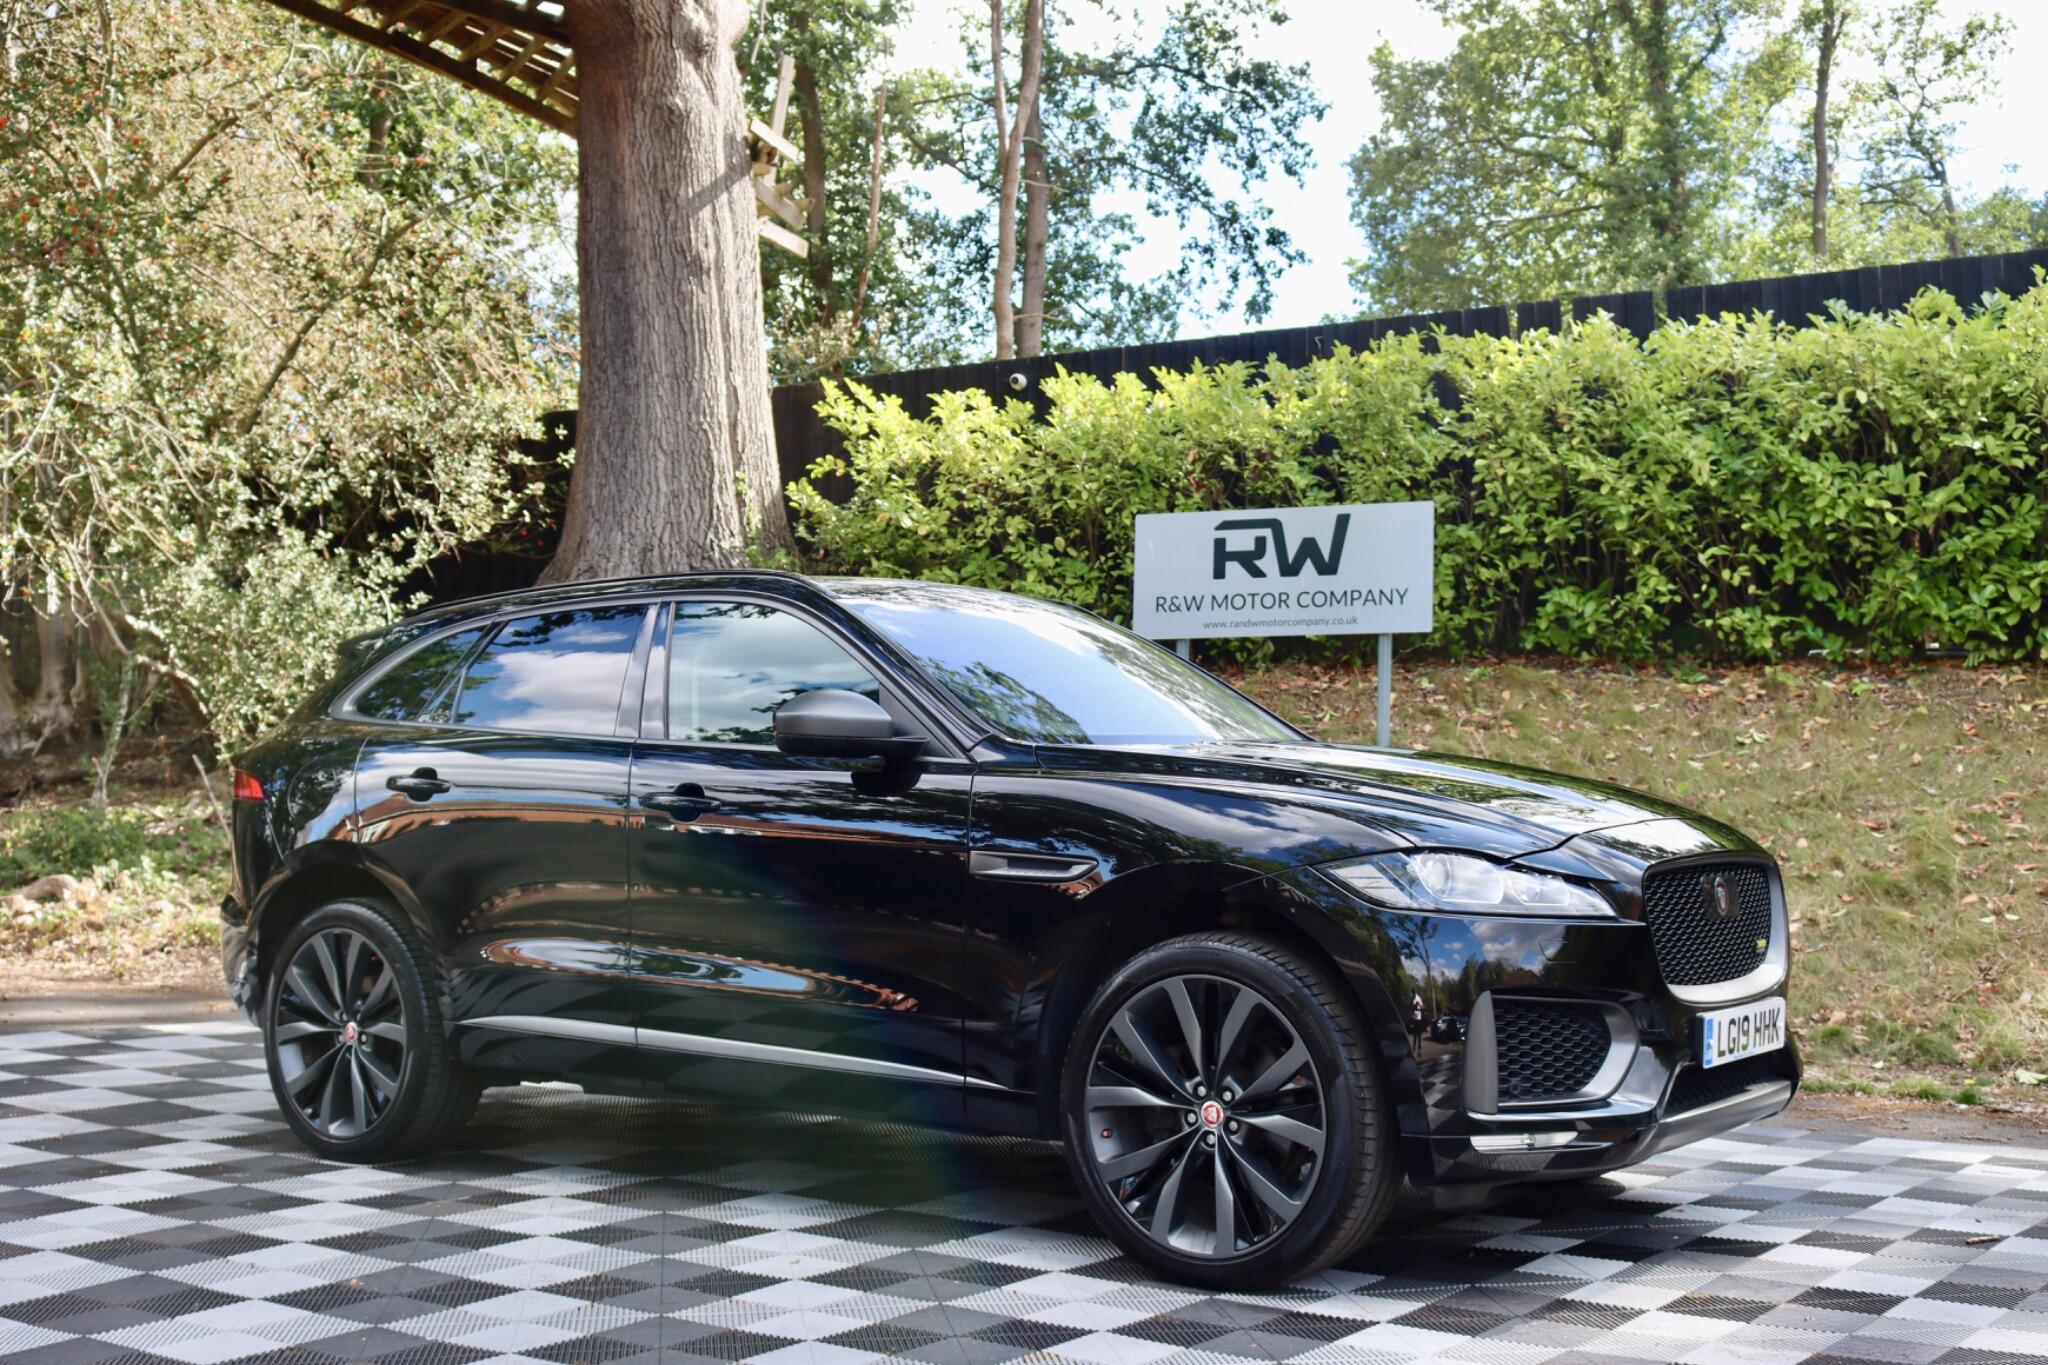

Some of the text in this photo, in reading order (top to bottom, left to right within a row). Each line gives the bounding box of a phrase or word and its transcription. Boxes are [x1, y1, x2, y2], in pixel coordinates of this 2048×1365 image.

[1213, 513, 1351, 579] RW
[1155, 588, 1409, 613] R&W MOTOR COMPANY
[1203, 616, 1358, 630] www.randwmotorcompany.co.uk
[1717, 1007, 1780, 1058] LG19 HHK
